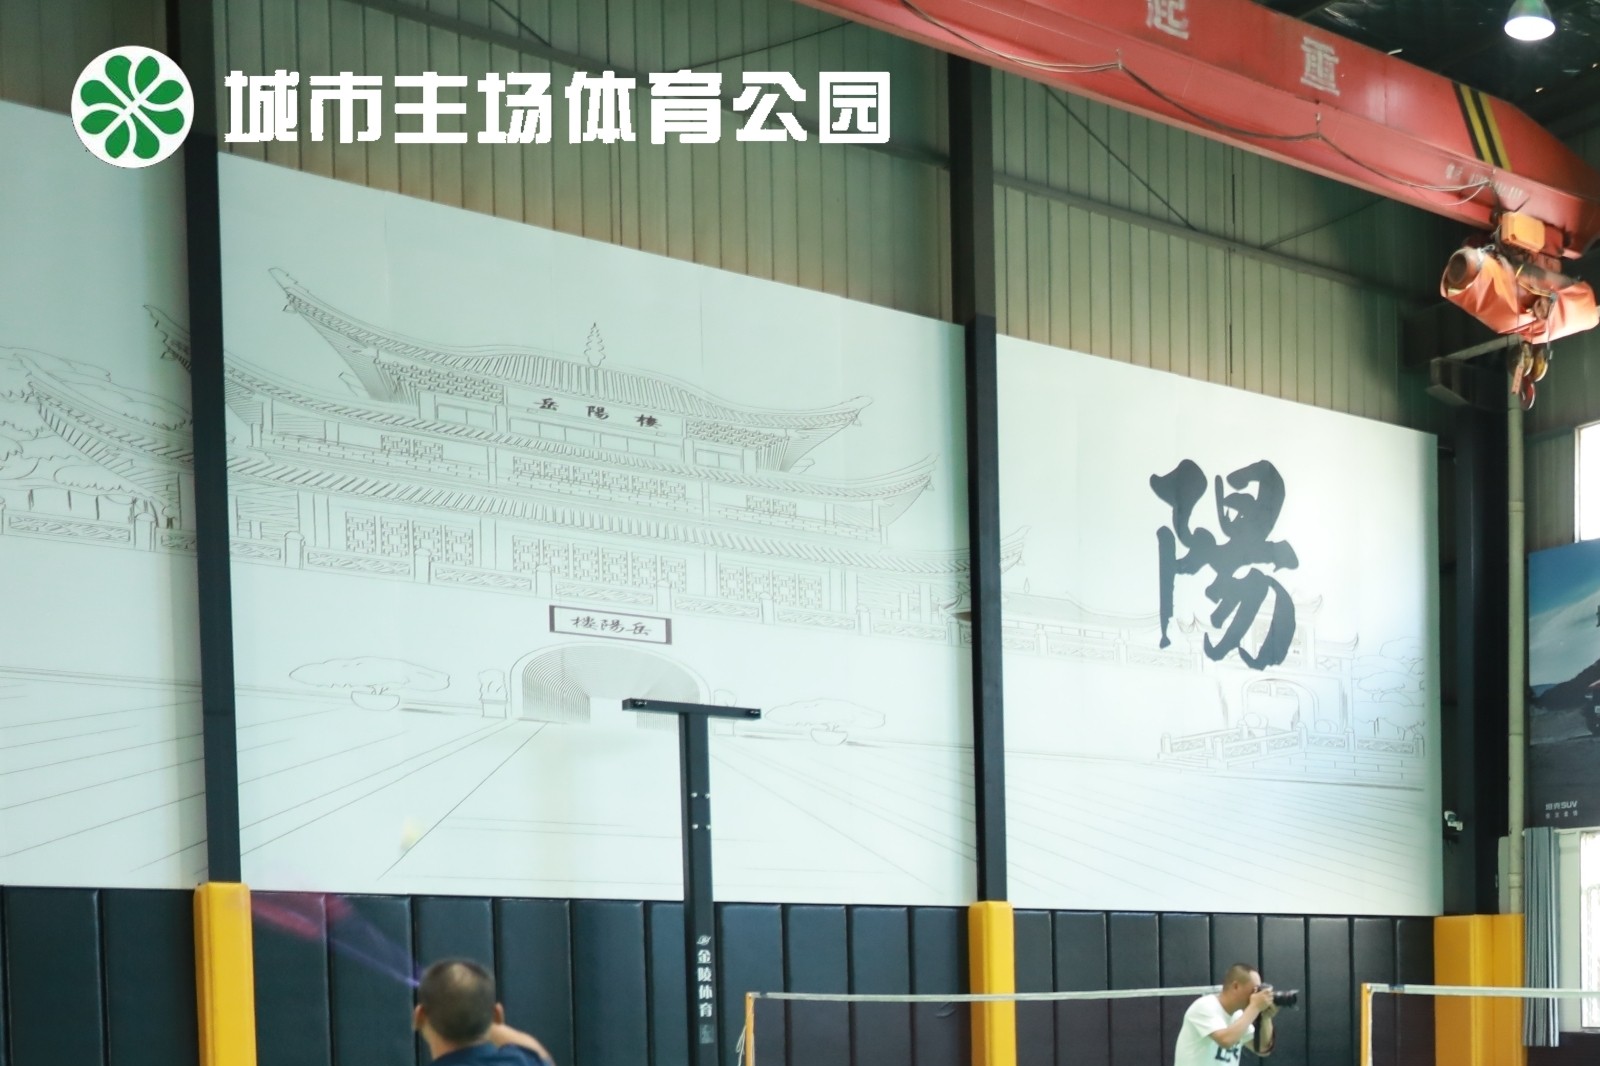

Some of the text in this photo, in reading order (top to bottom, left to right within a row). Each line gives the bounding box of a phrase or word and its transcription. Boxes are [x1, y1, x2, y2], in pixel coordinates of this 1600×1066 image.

[1149, 458, 1300, 671] 陽
[696, 948, 713, 1018] 金陵体育
